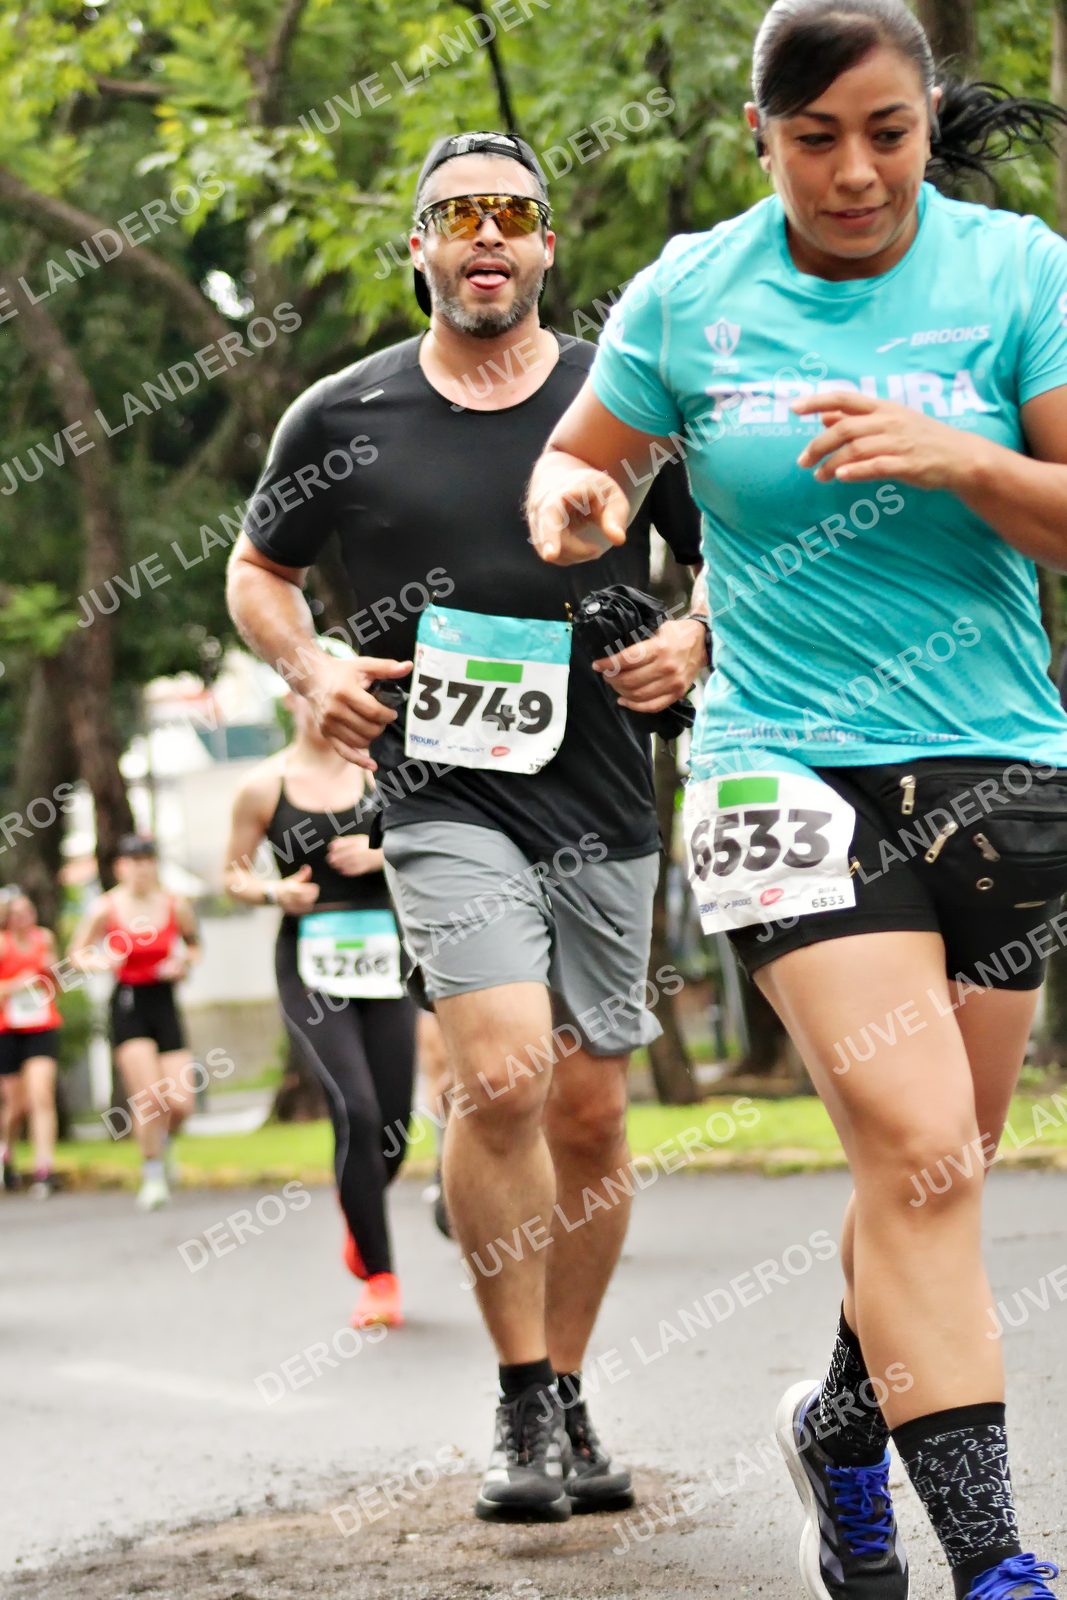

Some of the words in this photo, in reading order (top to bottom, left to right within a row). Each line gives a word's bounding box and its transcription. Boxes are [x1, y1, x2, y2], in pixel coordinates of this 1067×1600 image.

[910, 325, 992, 346] BROOKS
[412, 673, 553, 735] 3749
[691, 809, 832, 881] 6533
[811, 895, 845, 909] 6533
